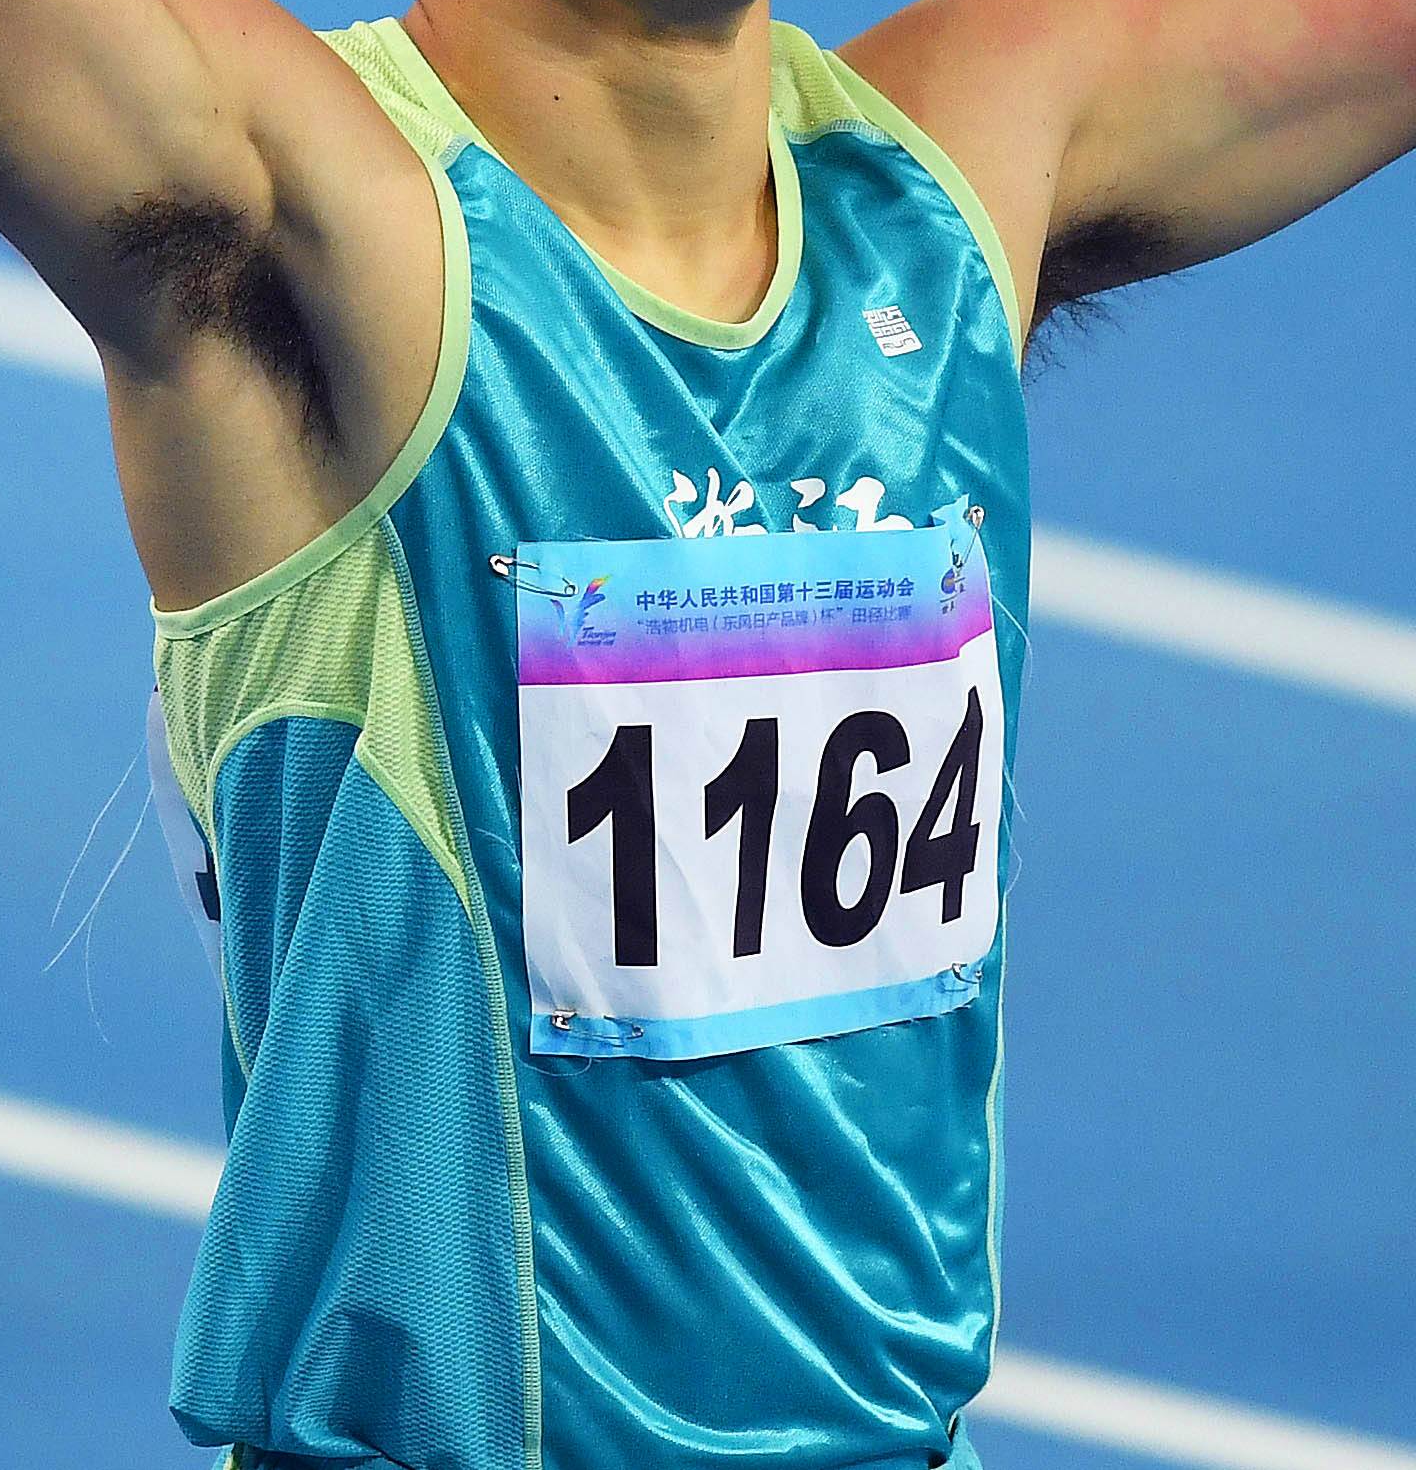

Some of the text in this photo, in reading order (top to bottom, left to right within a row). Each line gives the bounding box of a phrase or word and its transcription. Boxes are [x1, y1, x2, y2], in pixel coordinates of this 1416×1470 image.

[635, 577, 915, 612] 中华人民共和国第十三届运动会
[566, 684, 984, 968] 1164
